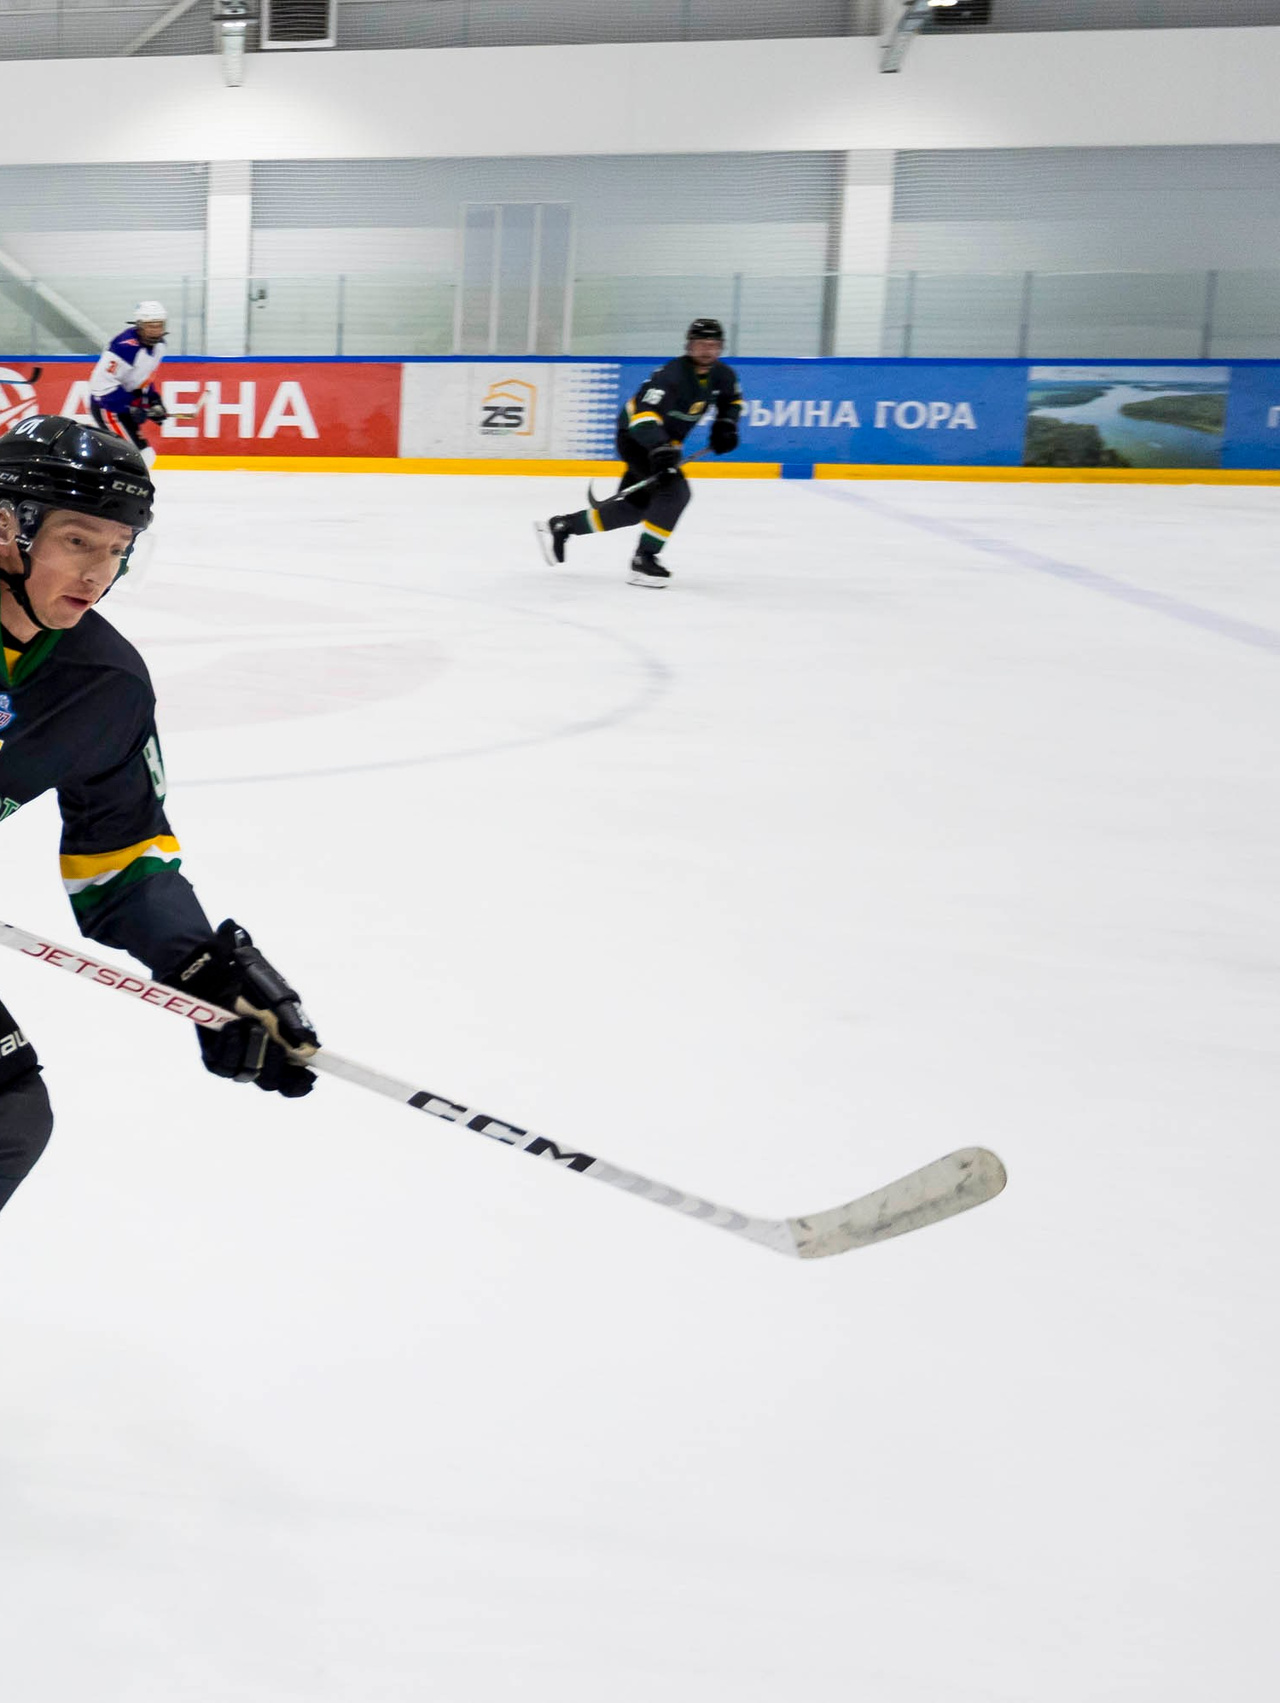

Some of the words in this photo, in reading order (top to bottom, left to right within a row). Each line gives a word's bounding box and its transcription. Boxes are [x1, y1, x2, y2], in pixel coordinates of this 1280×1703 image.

[59, 380, 320, 439] АЕНА
[481, 405, 524, 428] ZS
[874, 400, 978, 429] ГОРА
[111, 480, 150, 498] CCM
[22, 942, 216, 1025] JETSPEED
[407, 1090, 597, 1173] CCM
